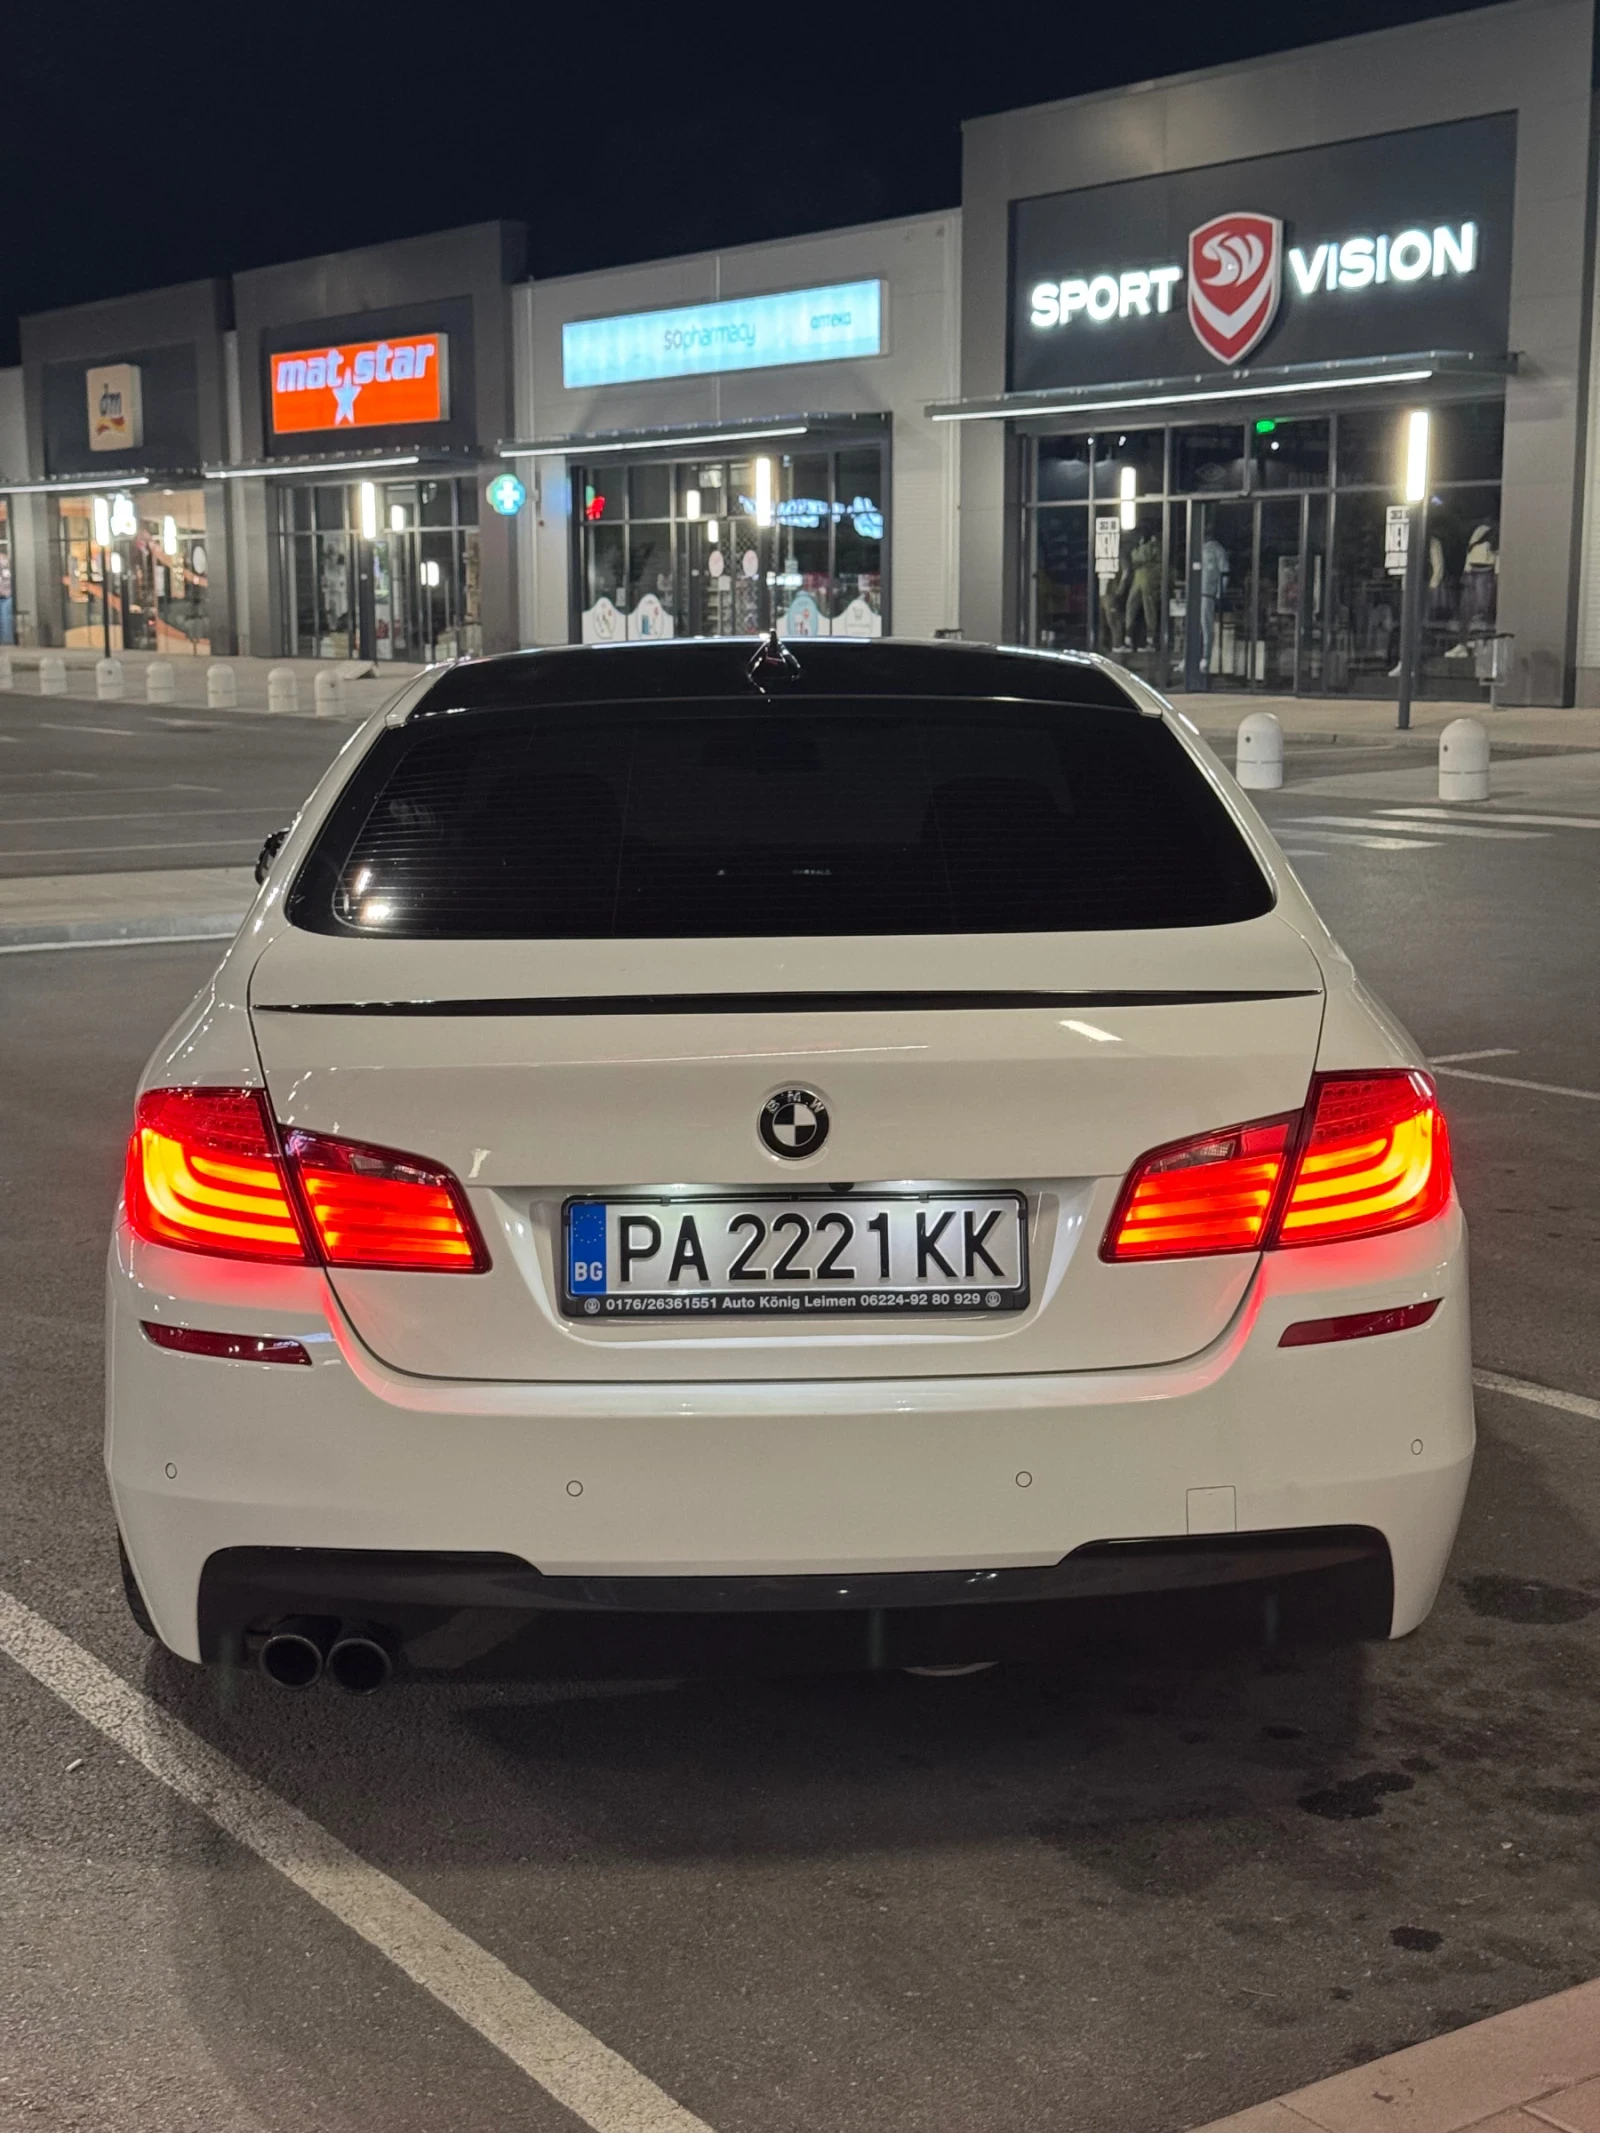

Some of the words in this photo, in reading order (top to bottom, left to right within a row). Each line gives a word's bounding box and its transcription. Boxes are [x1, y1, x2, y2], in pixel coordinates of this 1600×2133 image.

[1030, 265, 1182, 328] SPORT
[1288, 222, 1477, 295] VISION
[277, 348, 344, 393] mat
[353, 342, 435, 385] star
[766, 1090, 825, 1114] BMW
[620, 1214, 709, 1282] PA
[727, 1212, 889, 1280] 2221
[916, 1209, 1005, 1278] KK
[574, 1261, 603, 1282] BG
[606, 1298, 718, 1311] 0176/26361551
[722, 1297, 756, 1309] Auto
[760, 1295, 800, 1310] König
[804, 1295, 856, 1307] Leimen
[860, 1294, 928, 1306] 06224-92
[932, 1293, 950, 1305] 80
[954, 1292, 981, 1304] 929
